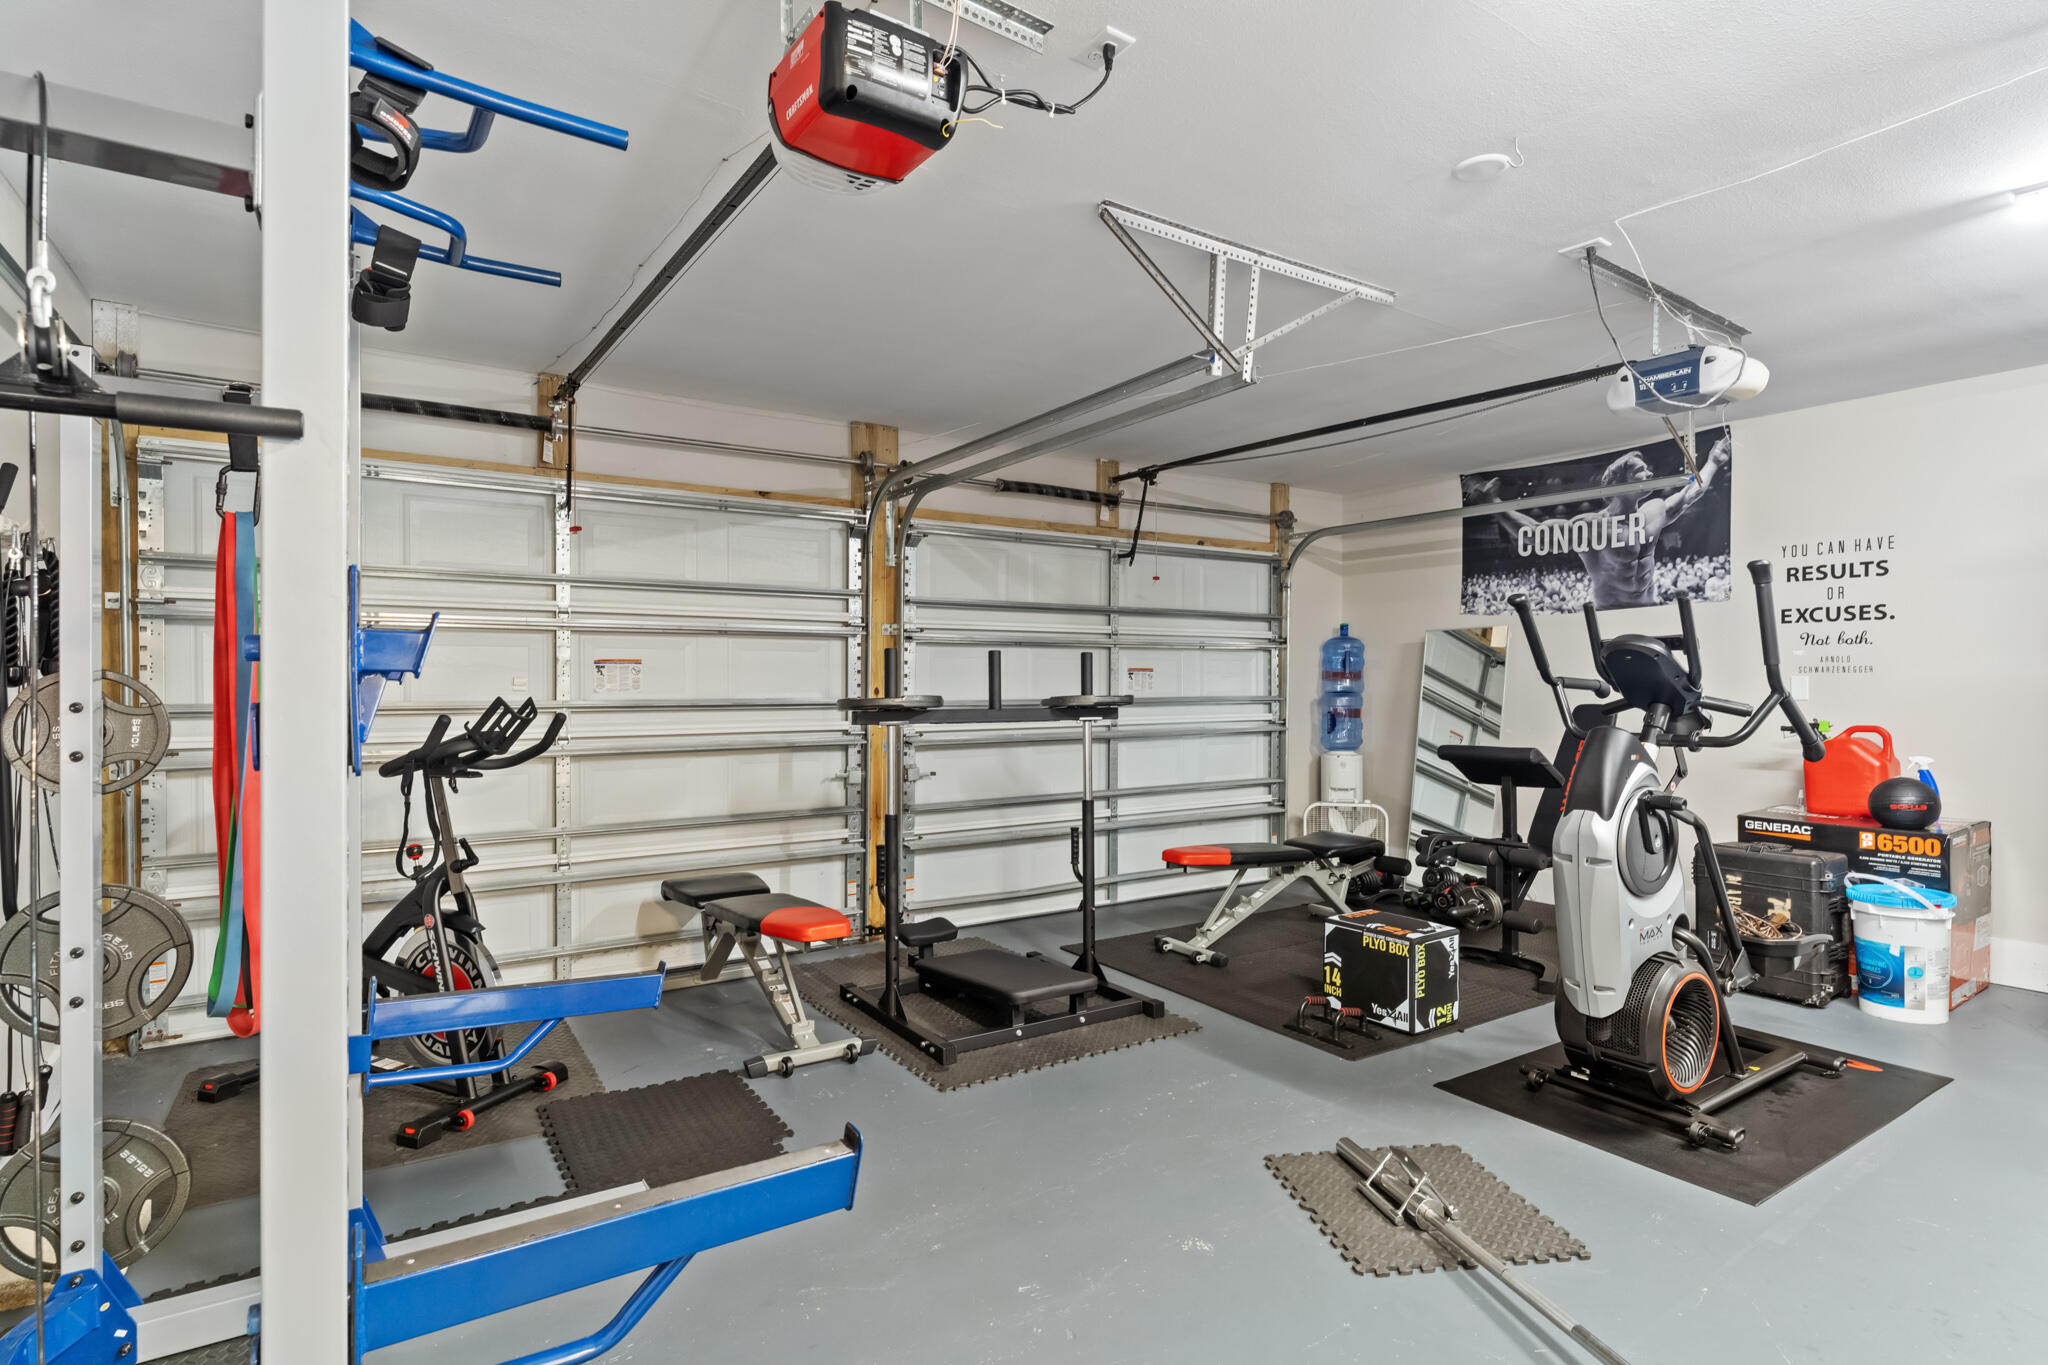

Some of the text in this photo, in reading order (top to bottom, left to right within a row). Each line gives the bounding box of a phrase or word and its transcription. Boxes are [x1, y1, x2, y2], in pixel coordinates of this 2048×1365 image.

[785, 83, 814, 120] CRAFTSMAN
[1781, 535, 1895, 558] YOU CAN HAVE
[1786, 559, 1890, 583] RESULTS
[1827, 586, 1845, 600] OR
[1780, 603, 1896, 625] EXCUSES.
[1799, 630, 1873, 647] Not both.
[1797, 665, 1874, 674] SCHWARZENEGGER
[1819, 655, 1852, 663] ARNOLD
[1744, 819, 1812, 835] GENERAC
[1877, 833, 1942, 857] 6500
[1639, 923, 1663, 942] MAX
[101, 933, 133, 961] GEAR
[1362, 935, 1410, 957] PLYO BOX
[1417, 943, 1426, 967] BOX
[1324, 965, 1342, 987] 14
[1417, 968, 1426, 998] PLYO
[1323, 983, 1342, 997] INCH
[1436, 1004, 1448, 1027] 12
